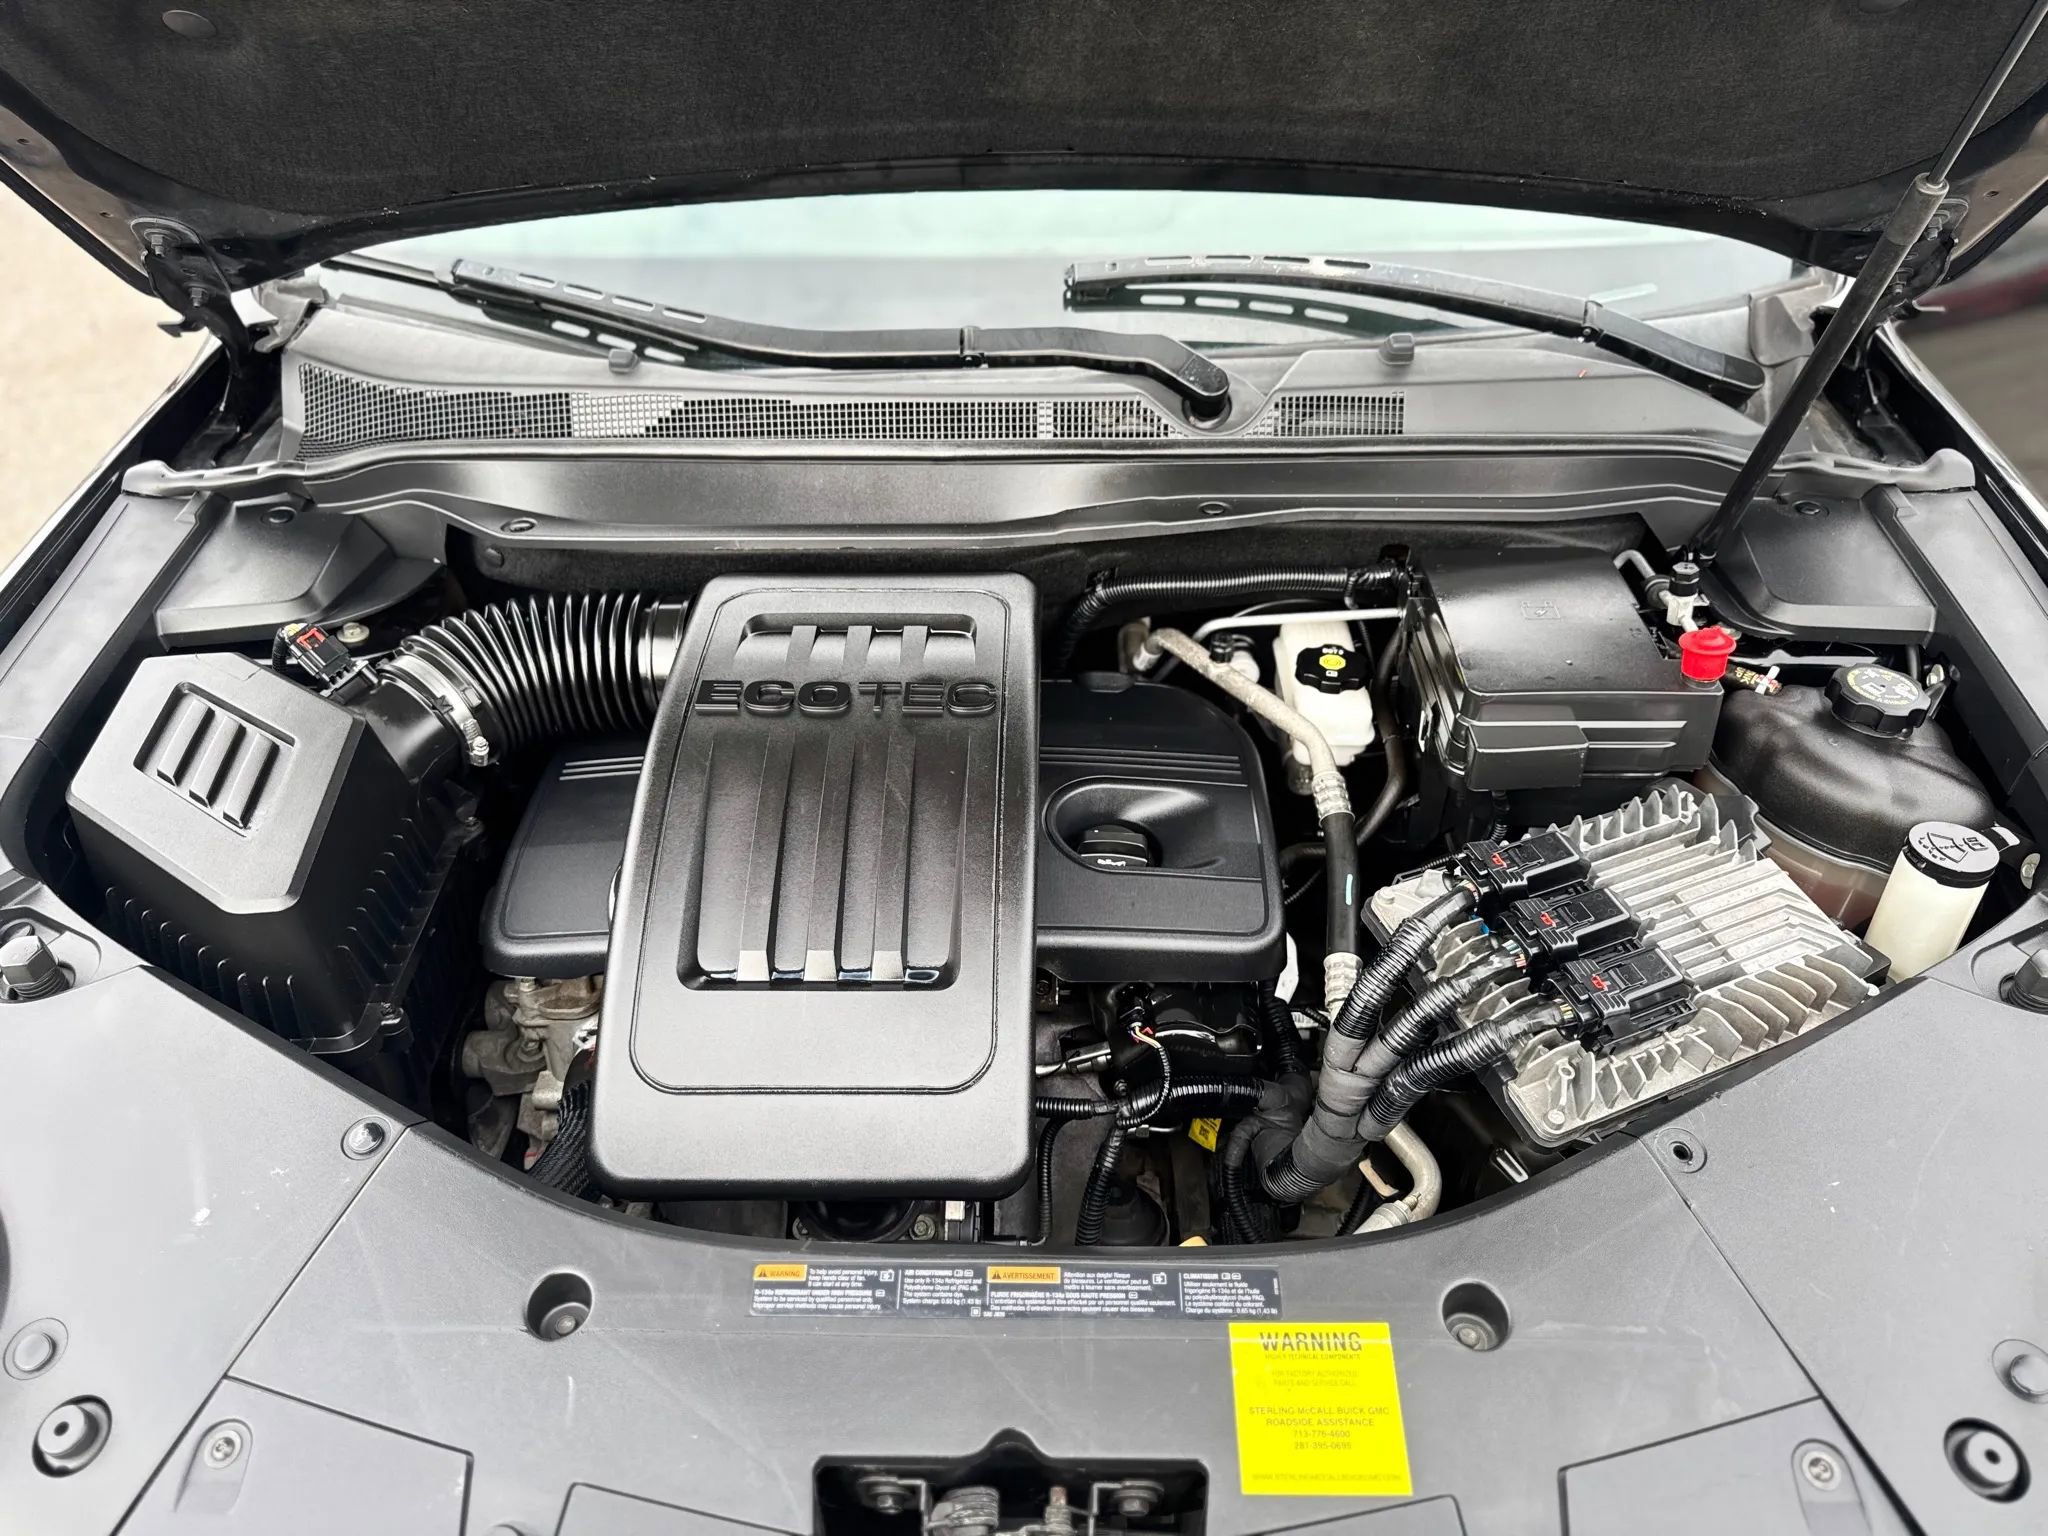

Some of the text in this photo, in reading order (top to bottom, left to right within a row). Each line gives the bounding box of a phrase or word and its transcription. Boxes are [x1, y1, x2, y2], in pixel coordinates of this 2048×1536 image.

[694, 680, 997, 714] ECOTEC
[1002, 1272, 1055, 1280] AVERTISSEMENT
[1260, 1331, 1362, 1351] WARNING
[1249, 1406, 1390, 1415] STERLING McCALL BUICK GMC
[1265, 1418, 1375, 1426] ROADSIDE ASSISTANCE
